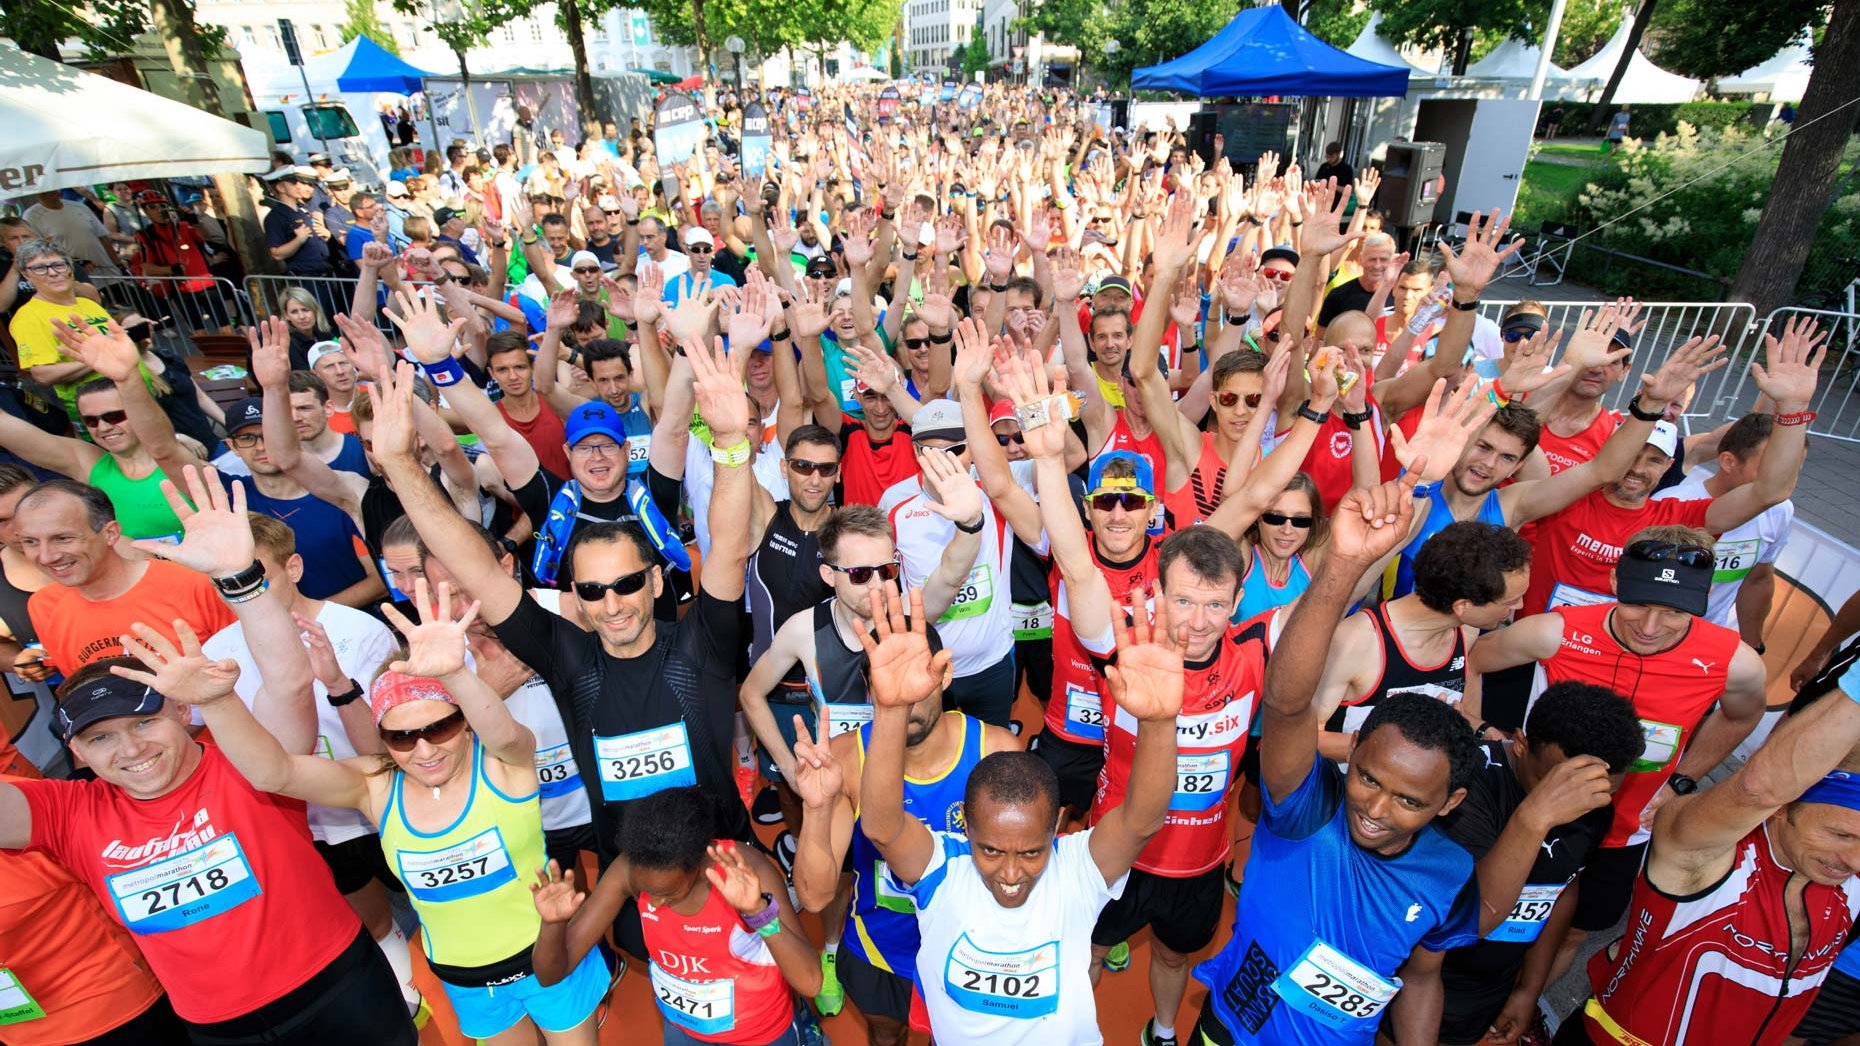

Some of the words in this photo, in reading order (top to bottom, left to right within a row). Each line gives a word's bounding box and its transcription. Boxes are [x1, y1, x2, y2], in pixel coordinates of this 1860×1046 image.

[671, 104, 694, 120] cep
[753, 117, 767, 133] cep
[630, 447, 648, 461] 52
[952, 586, 978, 605] 59
[1022, 618, 1040, 635] 18
[1561, 637, 1601, 656] Erlangen
[1572, 631, 1593, 645] LG
[612, 750, 675, 780] 3256
[420, 856, 488, 888] 3257
[142, 868, 229, 915] 2718
[1507, 926, 1526, 934] Riad
[659, 949, 711, 975] DJK
[962, 970, 1041, 999] 2102
[660, 986, 712, 1019] 2471
[981, 998, 1020, 1011] Samuel
[1304, 973, 1381, 1019] 2285
